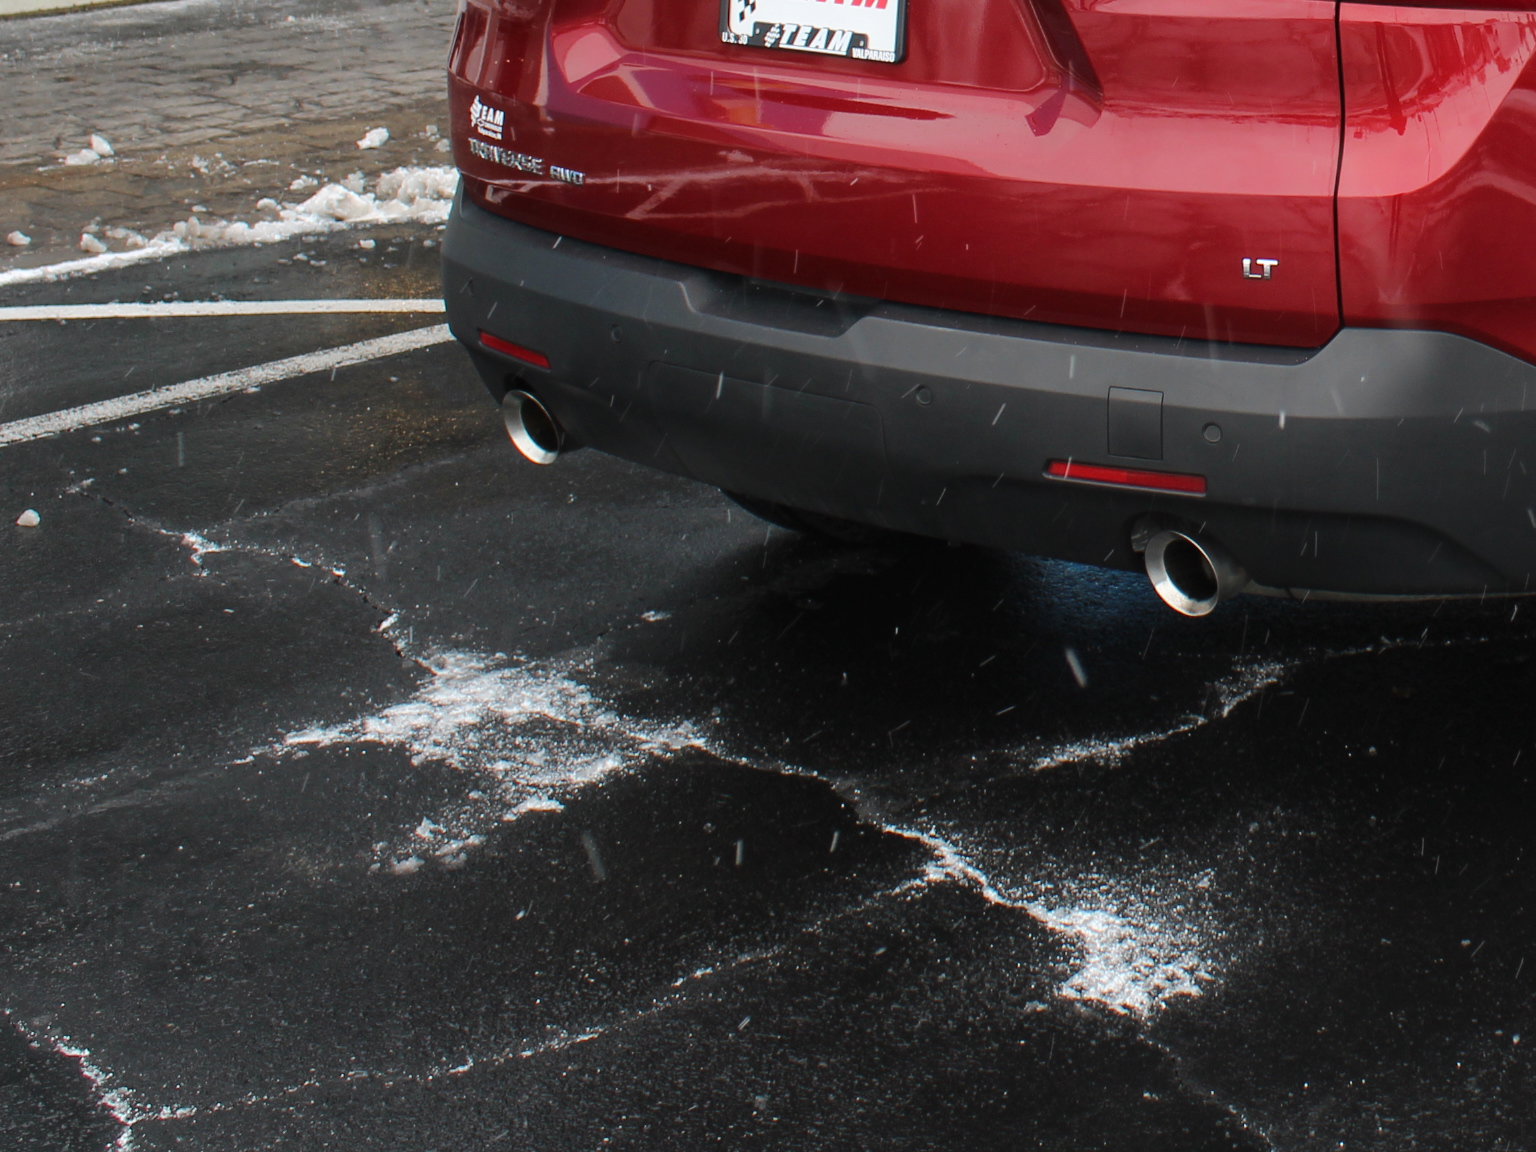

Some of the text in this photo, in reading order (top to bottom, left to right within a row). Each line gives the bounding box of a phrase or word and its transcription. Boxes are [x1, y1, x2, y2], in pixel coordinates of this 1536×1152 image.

[721, 31, 738, 44] U.S.
[779, 22, 854, 53] TEAM
[852, 48, 896, 63] VALPARAISO
[550, 165, 585, 185] AWD
[1242, 257, 1279, 280] LT
